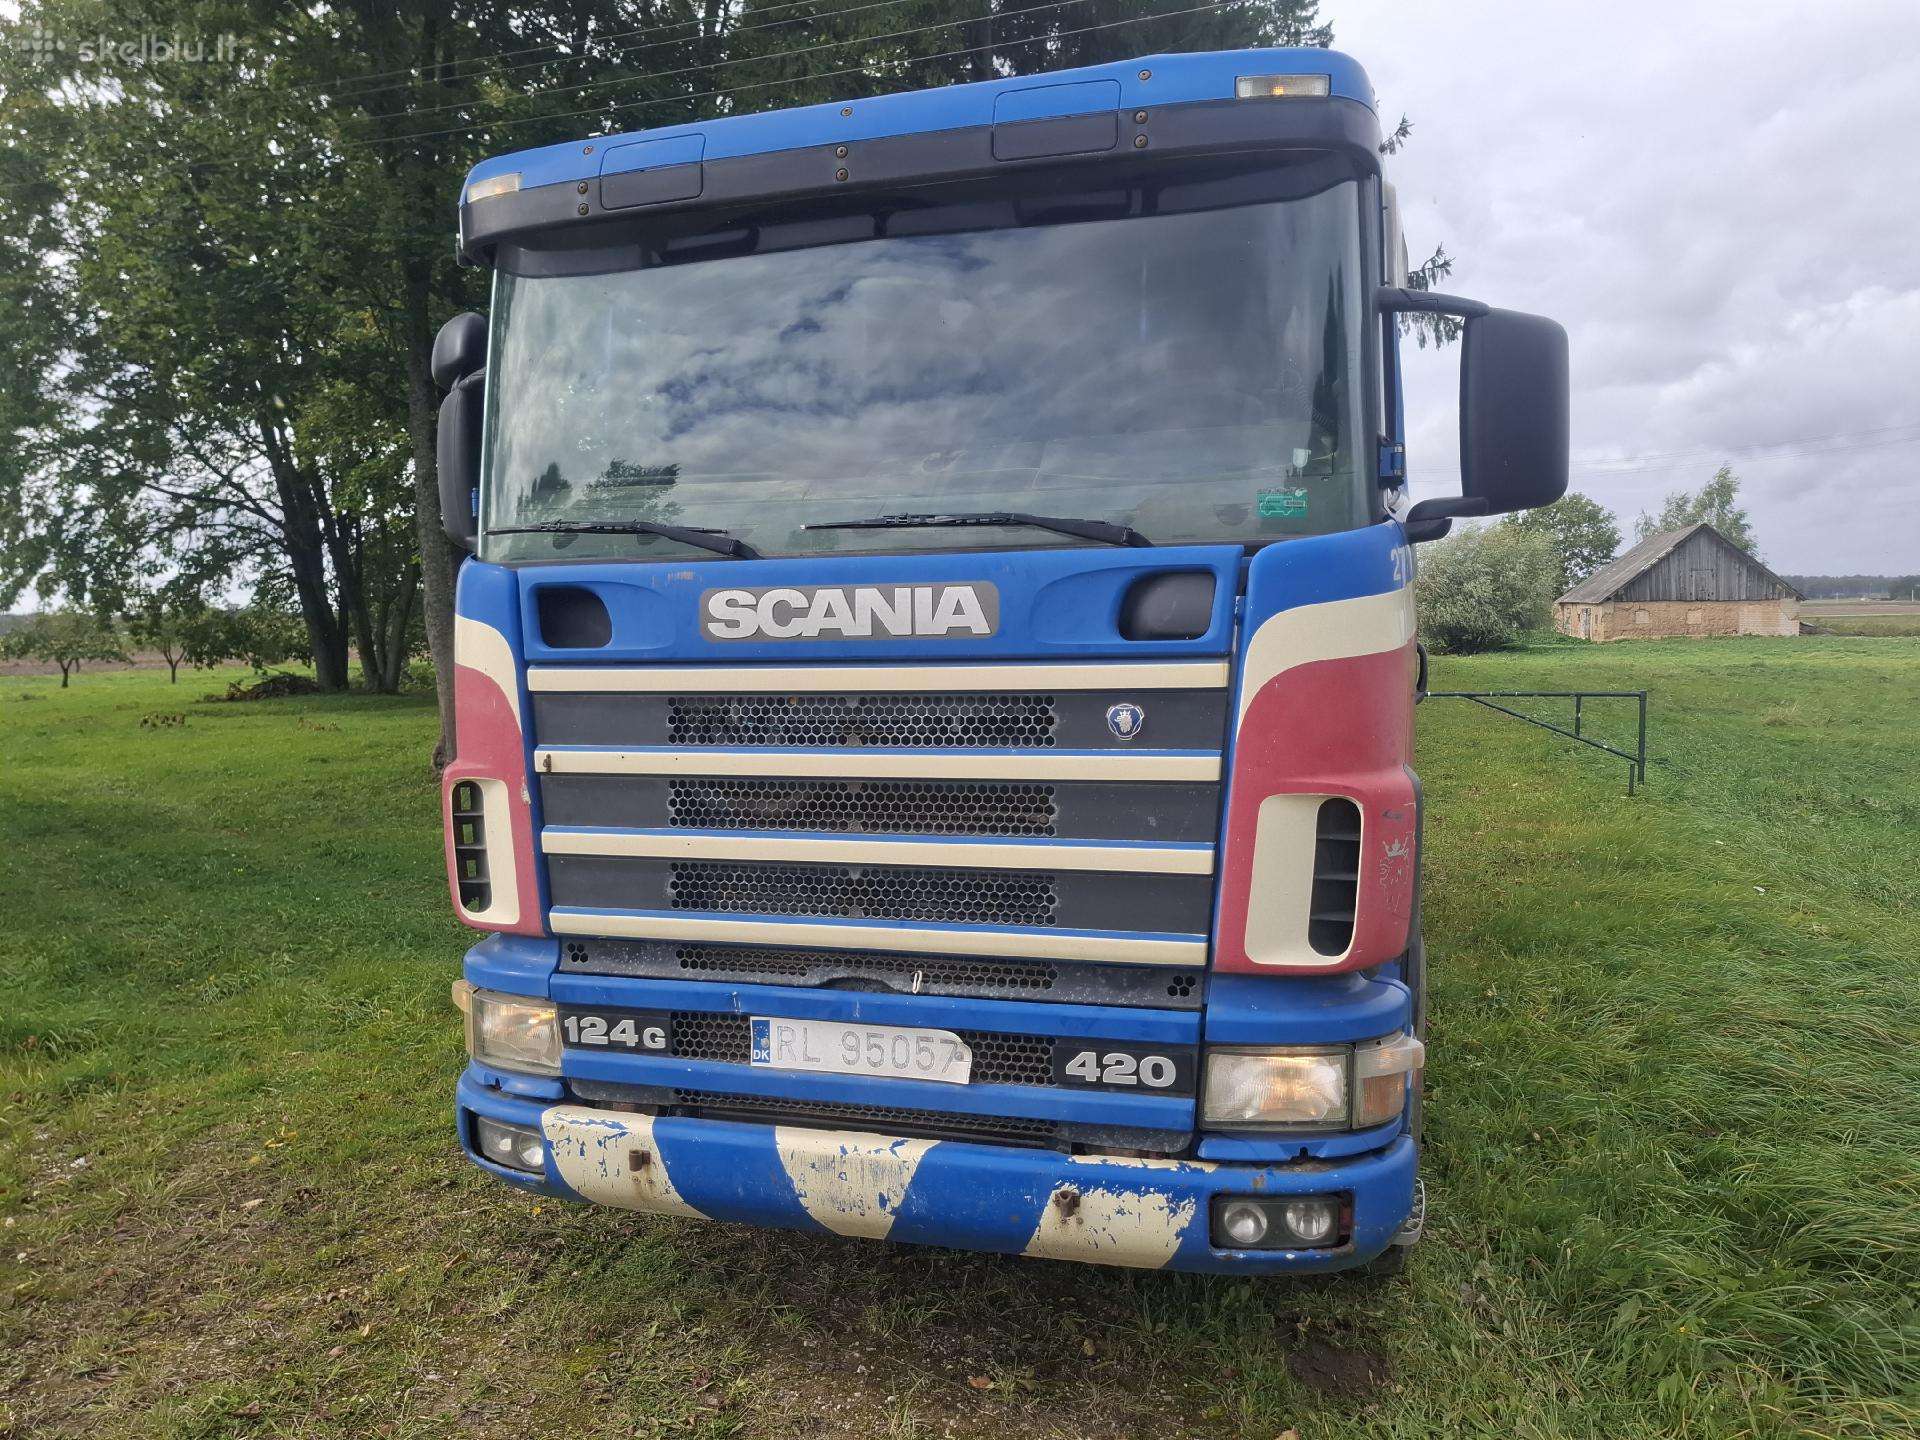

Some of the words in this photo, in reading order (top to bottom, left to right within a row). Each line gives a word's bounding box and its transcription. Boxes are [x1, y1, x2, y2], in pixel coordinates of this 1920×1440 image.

[707, 586, 991, 639] SCANIA
[753, 1049, 770, 1061] DK
[776, 1025, 821, 1063] RL
[841, 1030, 959, 1074] 95057
[1065, 1051, 1177, 1088] 420
